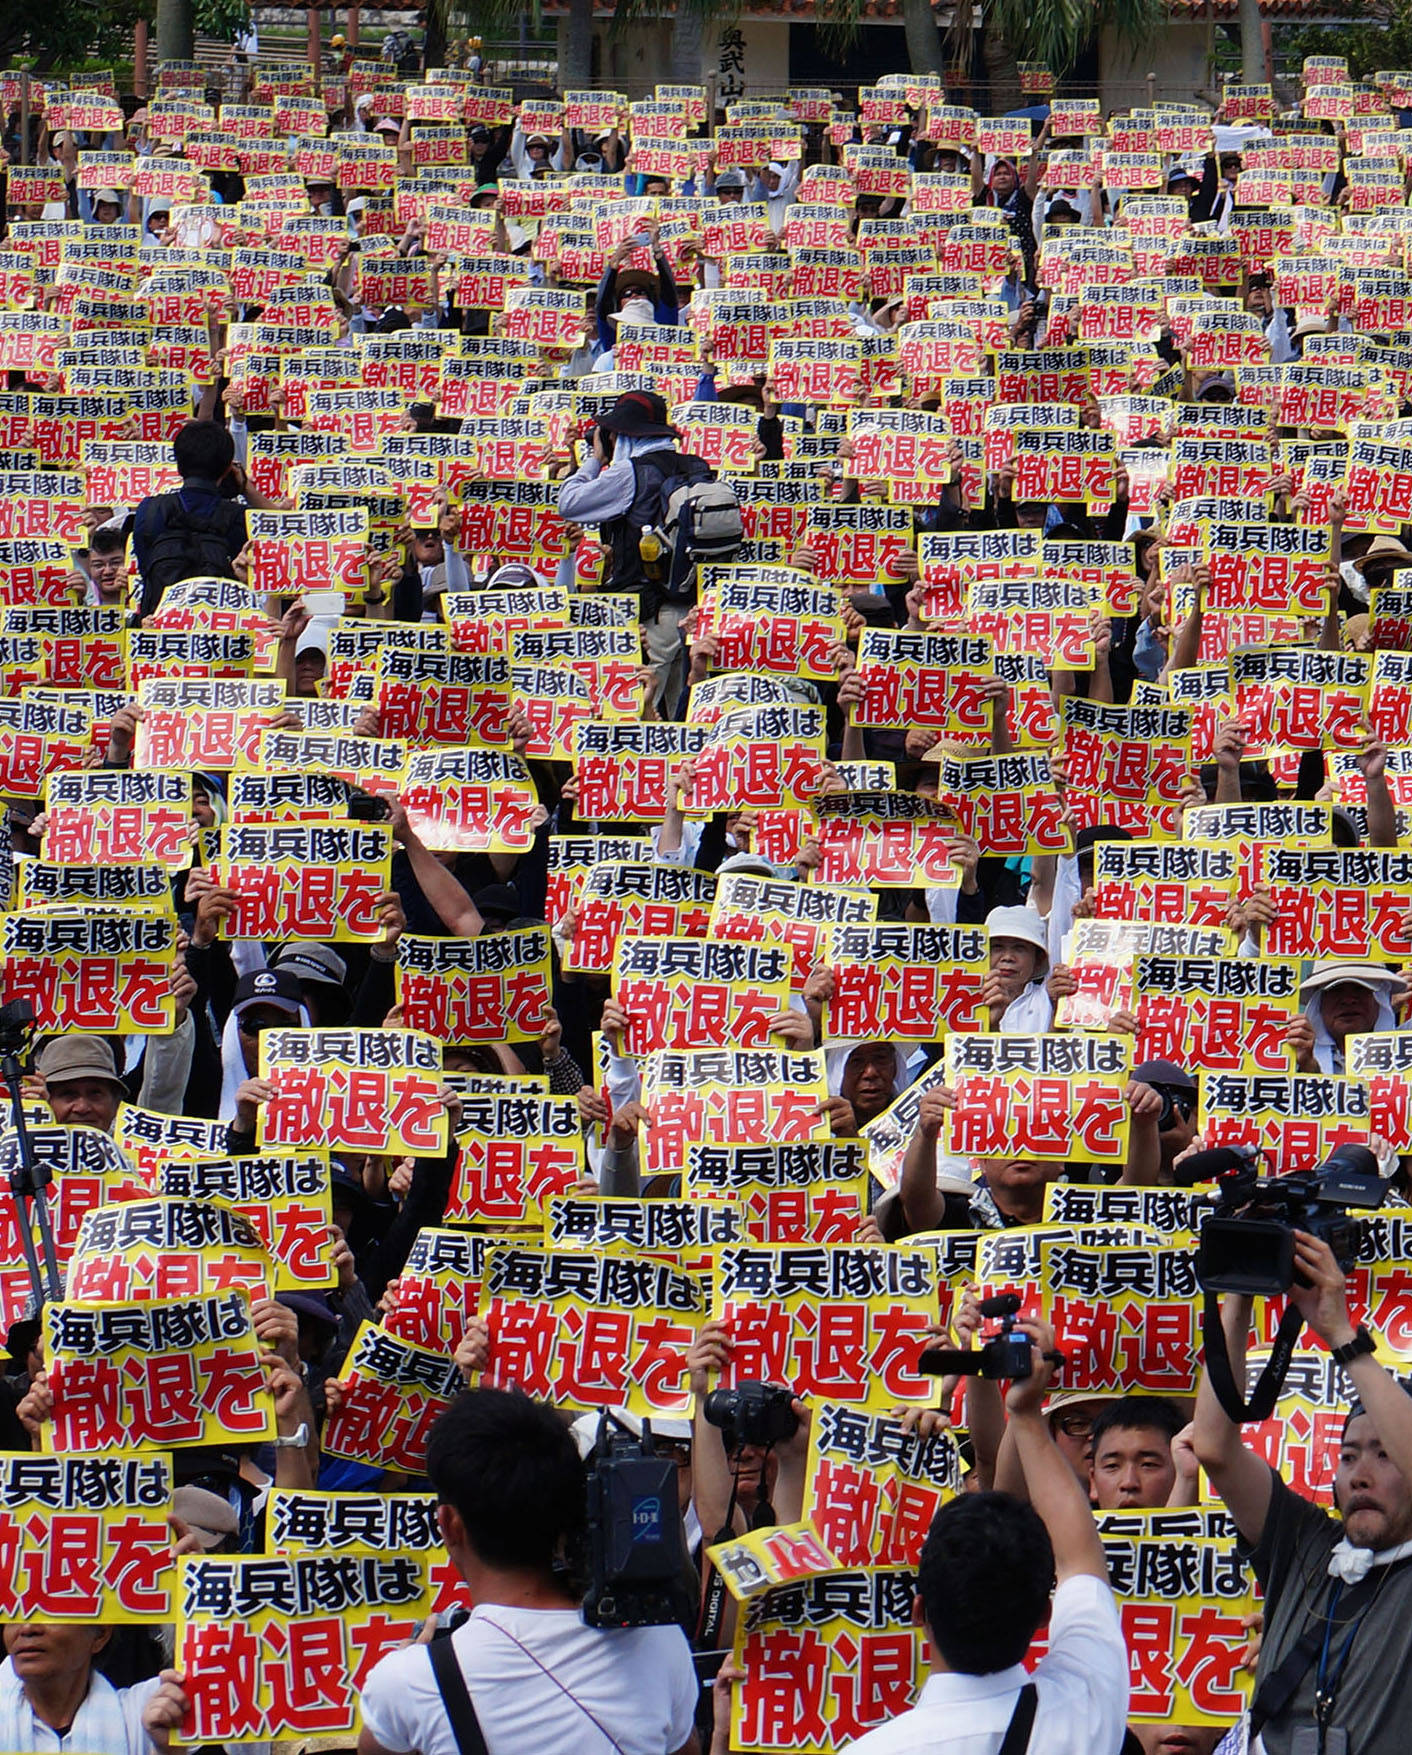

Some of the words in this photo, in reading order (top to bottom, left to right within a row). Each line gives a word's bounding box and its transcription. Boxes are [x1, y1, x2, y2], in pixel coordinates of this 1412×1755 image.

[1307, 58, 1346, 66] 海兵隊は
[1225, 99, 1269, 116] 撤退を
[1226, 86, 1268, 96] 海兵隊は
[10, 168, 62, 178] 海兵隊は
[81, 153, 132, 162] 海兵隊は
[9, 181, 62, 201] 撤退を
[136, 174, 192, 195] 撤退を
[1238, 182, 1289, 202] 撤退を
[510, 291, 583, 308] 海兵隊は
[508, 310, 582, 343] 撤退を
[620, 325, 695, 343] 海兵隊は
[851, 411, 948, 434] 海兵隊は
[848, 435, 950, 478] 撤退を
[808, 506, 911, 530] 海兵隊は
[1209, 525, 1328, 551] 海兵隊は
[251, 540, 364, 592] 撤退を
[1206, 553, 1326, 610] 撤退を
[720, 586, 837, 615] 海兵隊は
[382, 650, 509, 684] 海兵隊は
[710, 617, 833, 675] 撤退を
[861, 632, 990, 665] 海兵隊は
[1234, 653, 1367, 684] 海兵隊は
[144, 681, 282, 708] 海兵隊は
[379, 683, 509, 744] 撤退を
[854, 665, 990, 727] 撤退を
[1233, 684, 1366, 748] 撤退を
[1066, 699, 1190, 737] 海兵隊は
[405, 750, 530, 781] 海兵隊は
[682, 742, 822, 809] 撤退を
[1062, 727, 1187, 799] 撤退を
[49, 773, 189, 802] 海兵隊は
[46, 808, 188, 865] 撤退を
[1188, 805, 1328, 839] 海兵隊は
[227, 826, 389, 863] 海兵隊は
[814, 821, 958, 883] 撤退を
[1097, 846, 1236, 879] 海兵隊は
[23, 863, 167, 898] 海兵隊は
[225, 865, 383, 937] 撤退を
[4, 916, 172, 953] 海兵隊は
[399, 930, 548, 972] 海兵隊は
[830, 925, 986, 962] 海兵隊は
[620, 941, 789, 983] 海兵隊は
[1136, 956, 1295, 997] 海兵隊は
[401, 972, 551, 1043] 撤退を
[618, 978, 783, 1057] 撤退を
[826, 964, 985, 1037] 撤退を
[265, 1030, 440, 1069] 海兵隊は
[1134, 995, 1288, 1070] 撤退を
[644, 1051, 824, 1087] 海兵隊は
[953, 1036, 1127, 1074] 海兵隊は
[262, 1067, 443, 1148] 撤退を
[456, 1099, 579, 1136] 兵隊は
[949, 1076, 1127, 1156] 撤退を
[1203, 1074, 1369, 1118] 海兵隊は
[158, 1157, 327, 1201] 海兵隊は
[687, 1143, 863, 1187] 海兵隊は
[79, 1201, 262, 1256] 海兵隊は
[549, 1201, 745, 1247] 海兵隊は
[490, 1251, 702, 1310] 海兵隊は
[722, 1247, 932, 1298] 海兵隊は
[1048, 1247, 1201, 1298] 海兵隊
[47, 1298, 251, 1356] 海兵隊は
[1046, 1296, 1204, 1393] 撤退
[474, 1298, 697, 1412] 撤退を
[47, 1347, 267, 1453] 撤退を
[818, 1403, 964, 1489] 海兵隊
[0, 1457, 171, 1507] 兵隊は
[273, 1496, 441, 1549] 海兵隊
[183, 1558, 424, 1618] 海兵隊は
[1108, 1542, 1251, 1598] 兵隊は
[704, 1590, 721, 1637] DIGITAL
[746, 1571, 920, 1631] 海兵隊
[1120, 1603, 1246, 1716] 退を
[741, 1628, 930, 1747] 撤退
